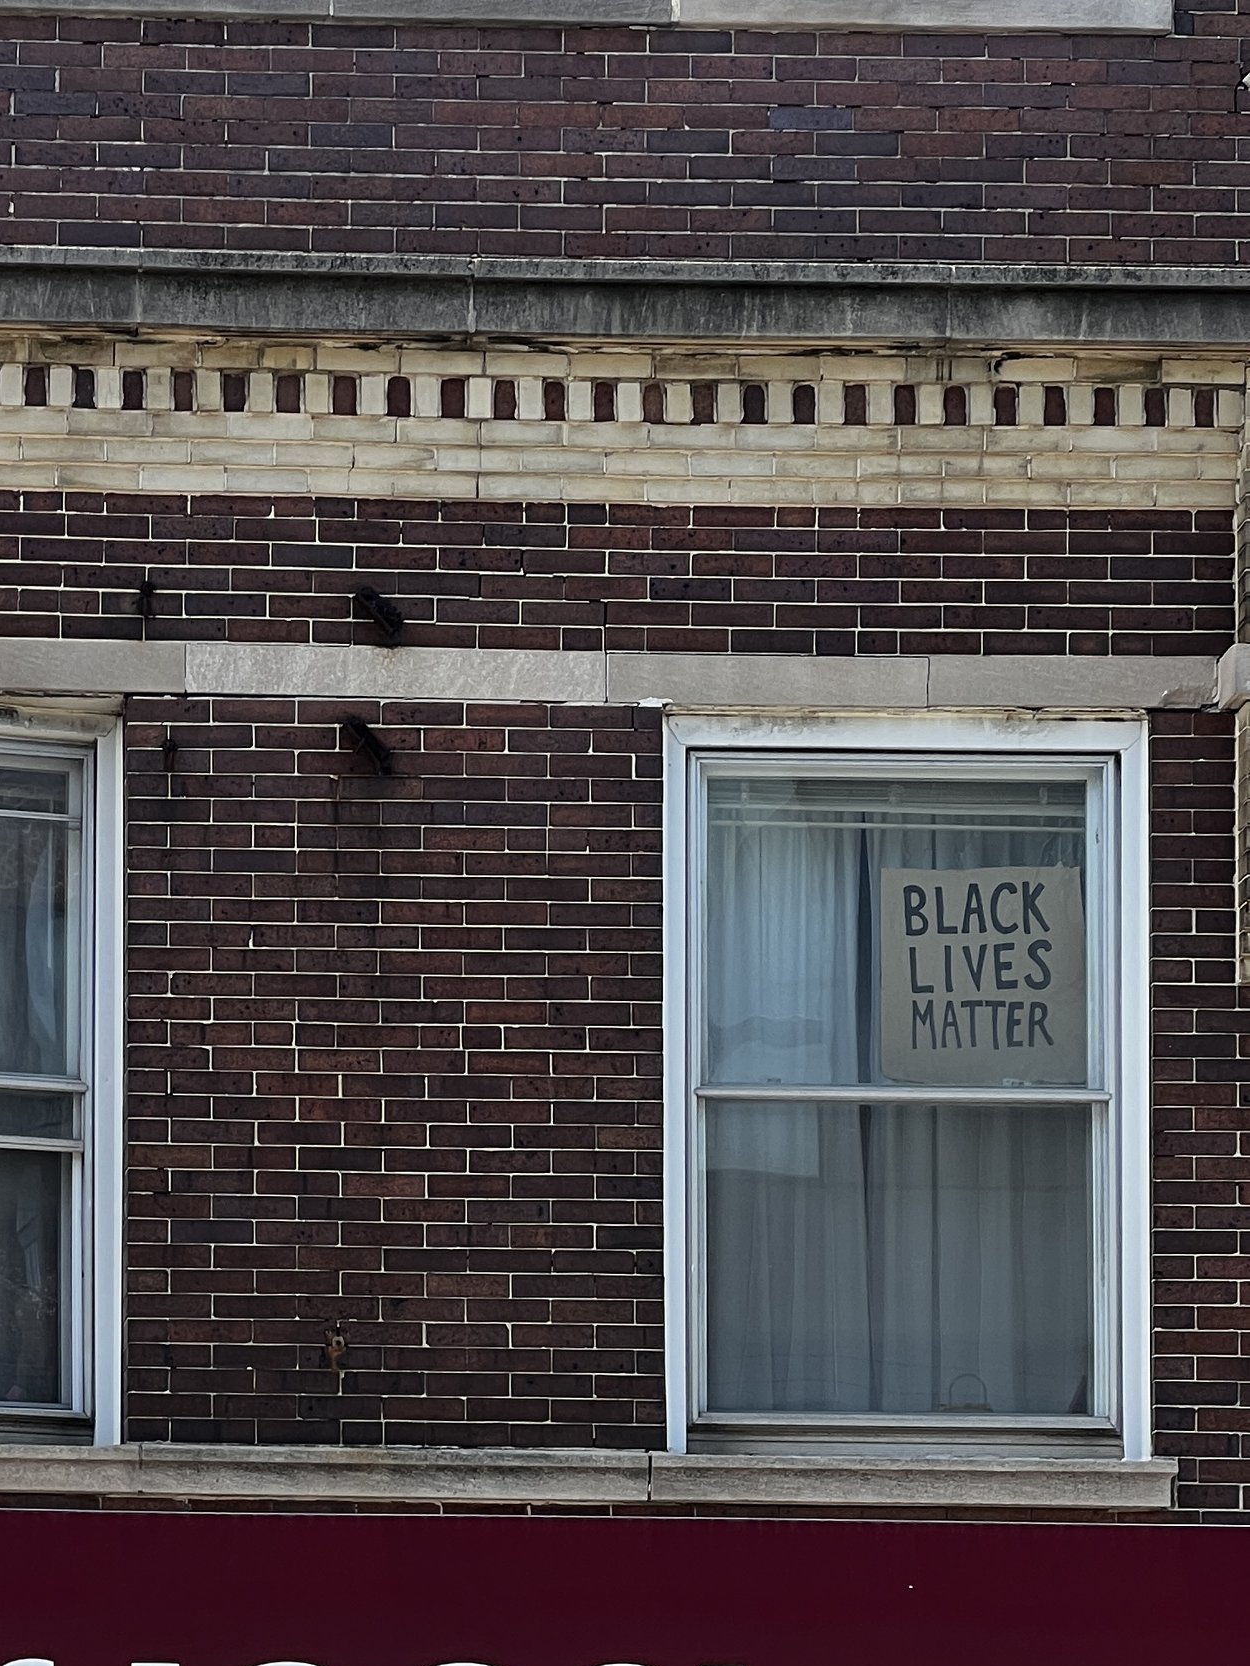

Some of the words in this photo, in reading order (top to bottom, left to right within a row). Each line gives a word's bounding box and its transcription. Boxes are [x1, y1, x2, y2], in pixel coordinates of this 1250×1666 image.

[903, 880, 1051, 936] BLACK
[909, 939, 1053, 994] LIVES
[911, 999, 1054, 1050] MATTER
